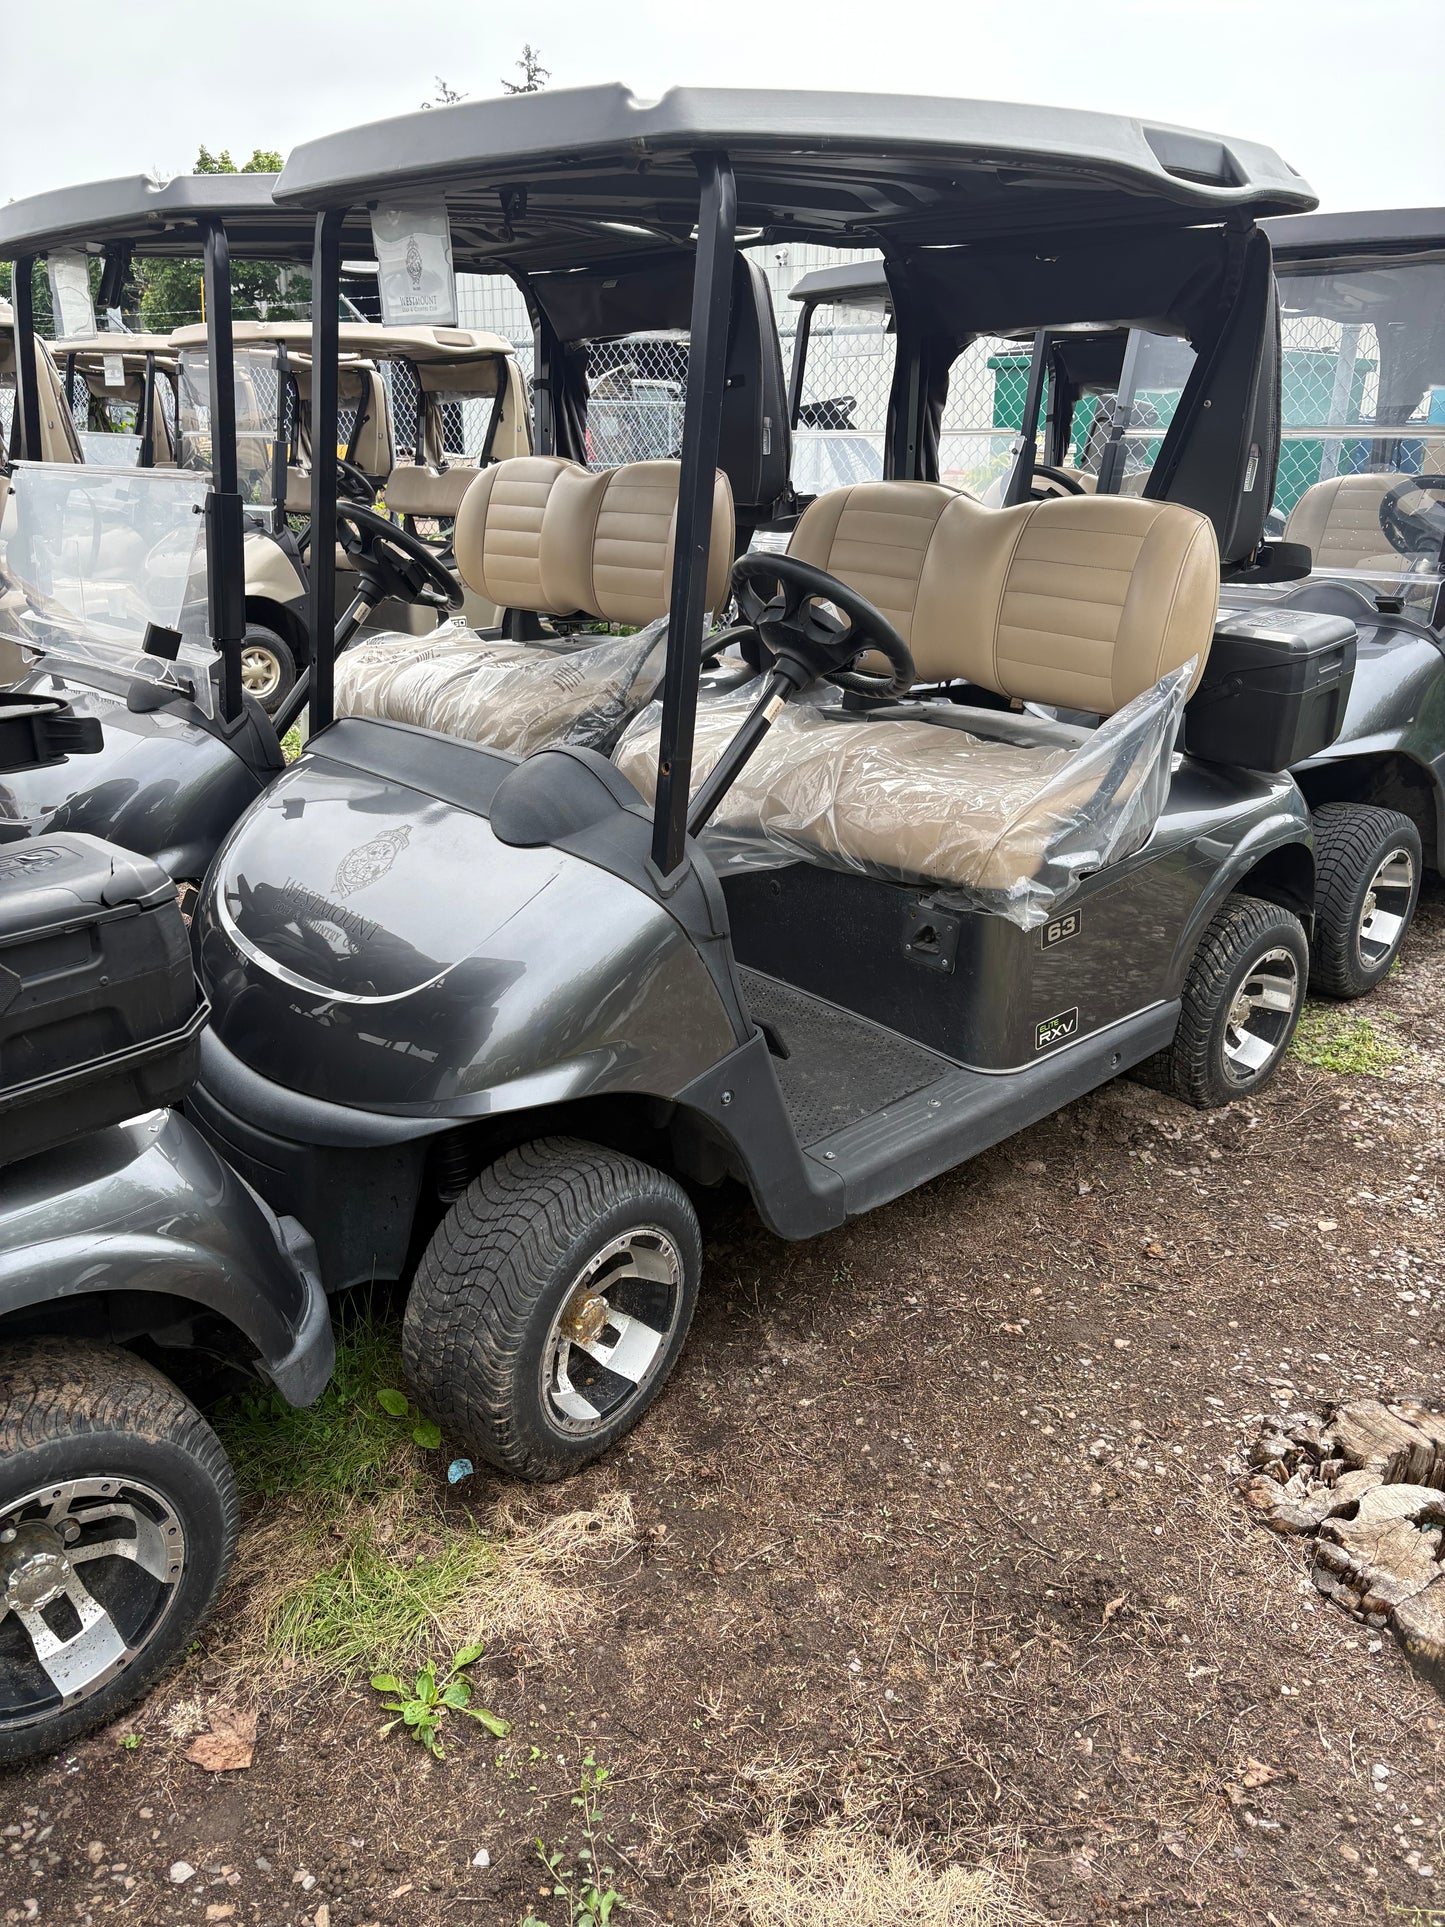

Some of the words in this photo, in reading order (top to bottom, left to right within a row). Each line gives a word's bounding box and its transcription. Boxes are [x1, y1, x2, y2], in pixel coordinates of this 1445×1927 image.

[399, 295, 437, 306] WESTMOUNT
[280, 876, 384, 941] WESTMOUNT
[1048, 916, 1076, 942] 63
[1039, 1019, 1060, 1033] ELITE
[1039, 1020, 1073, 1045] RXV
